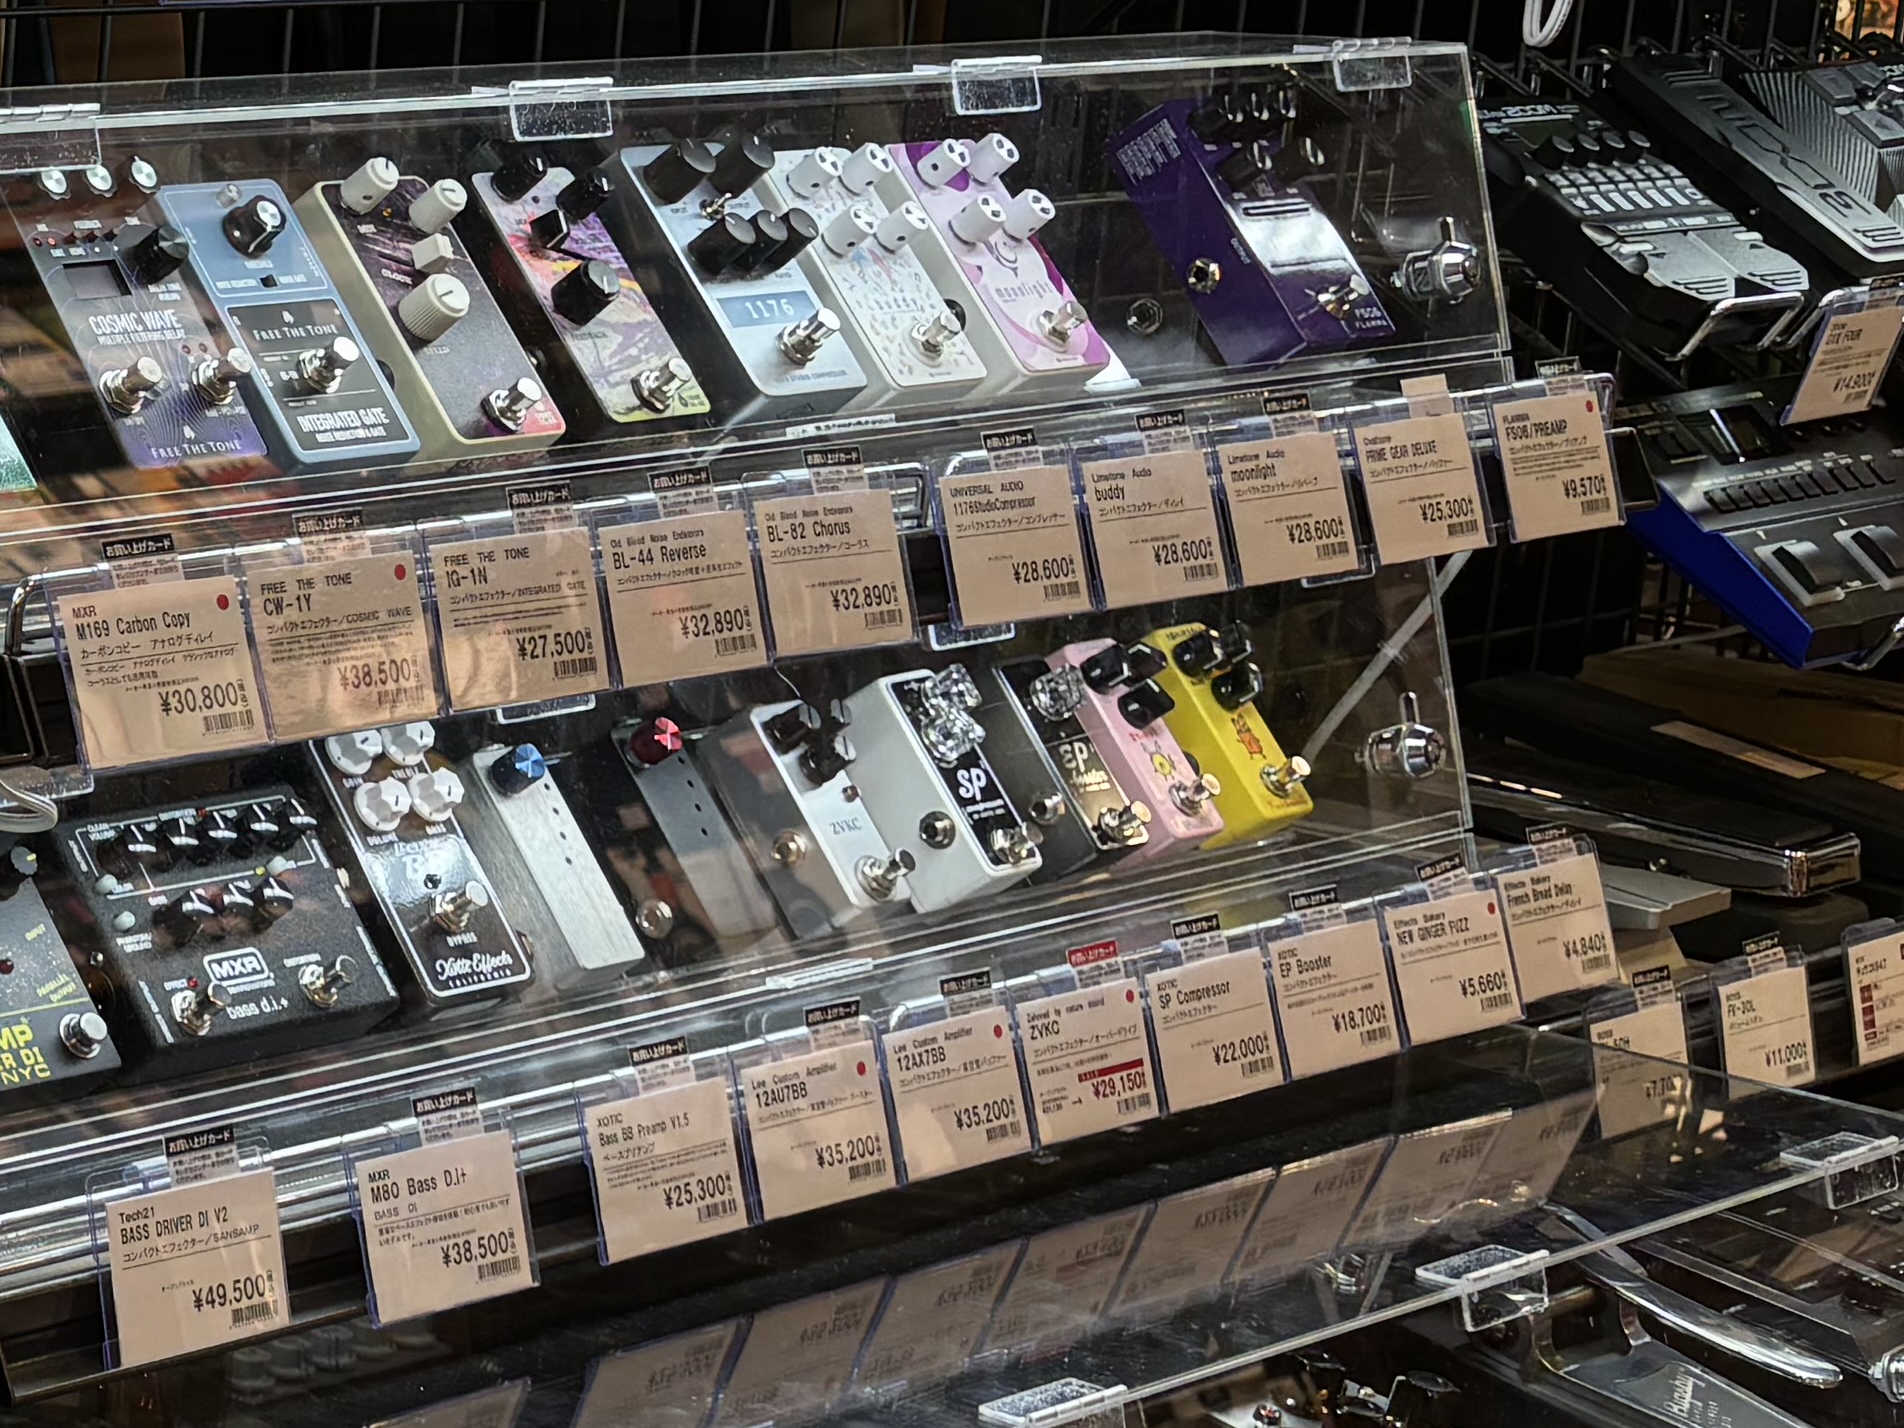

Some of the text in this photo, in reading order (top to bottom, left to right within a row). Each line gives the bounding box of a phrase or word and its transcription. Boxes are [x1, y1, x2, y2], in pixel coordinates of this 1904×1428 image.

[1286, 519, 1343, 544] ¥28,600
[76, 610, 191, 641] M169 Carbon Copy
[680, 608, 746, 640] ¥32,890
[160, 683, 239, 717] ¥30,800
[1212, 1034, 1269, 1067] ¥22,000
[442, 1231, 509, 1267] ¥38,500
